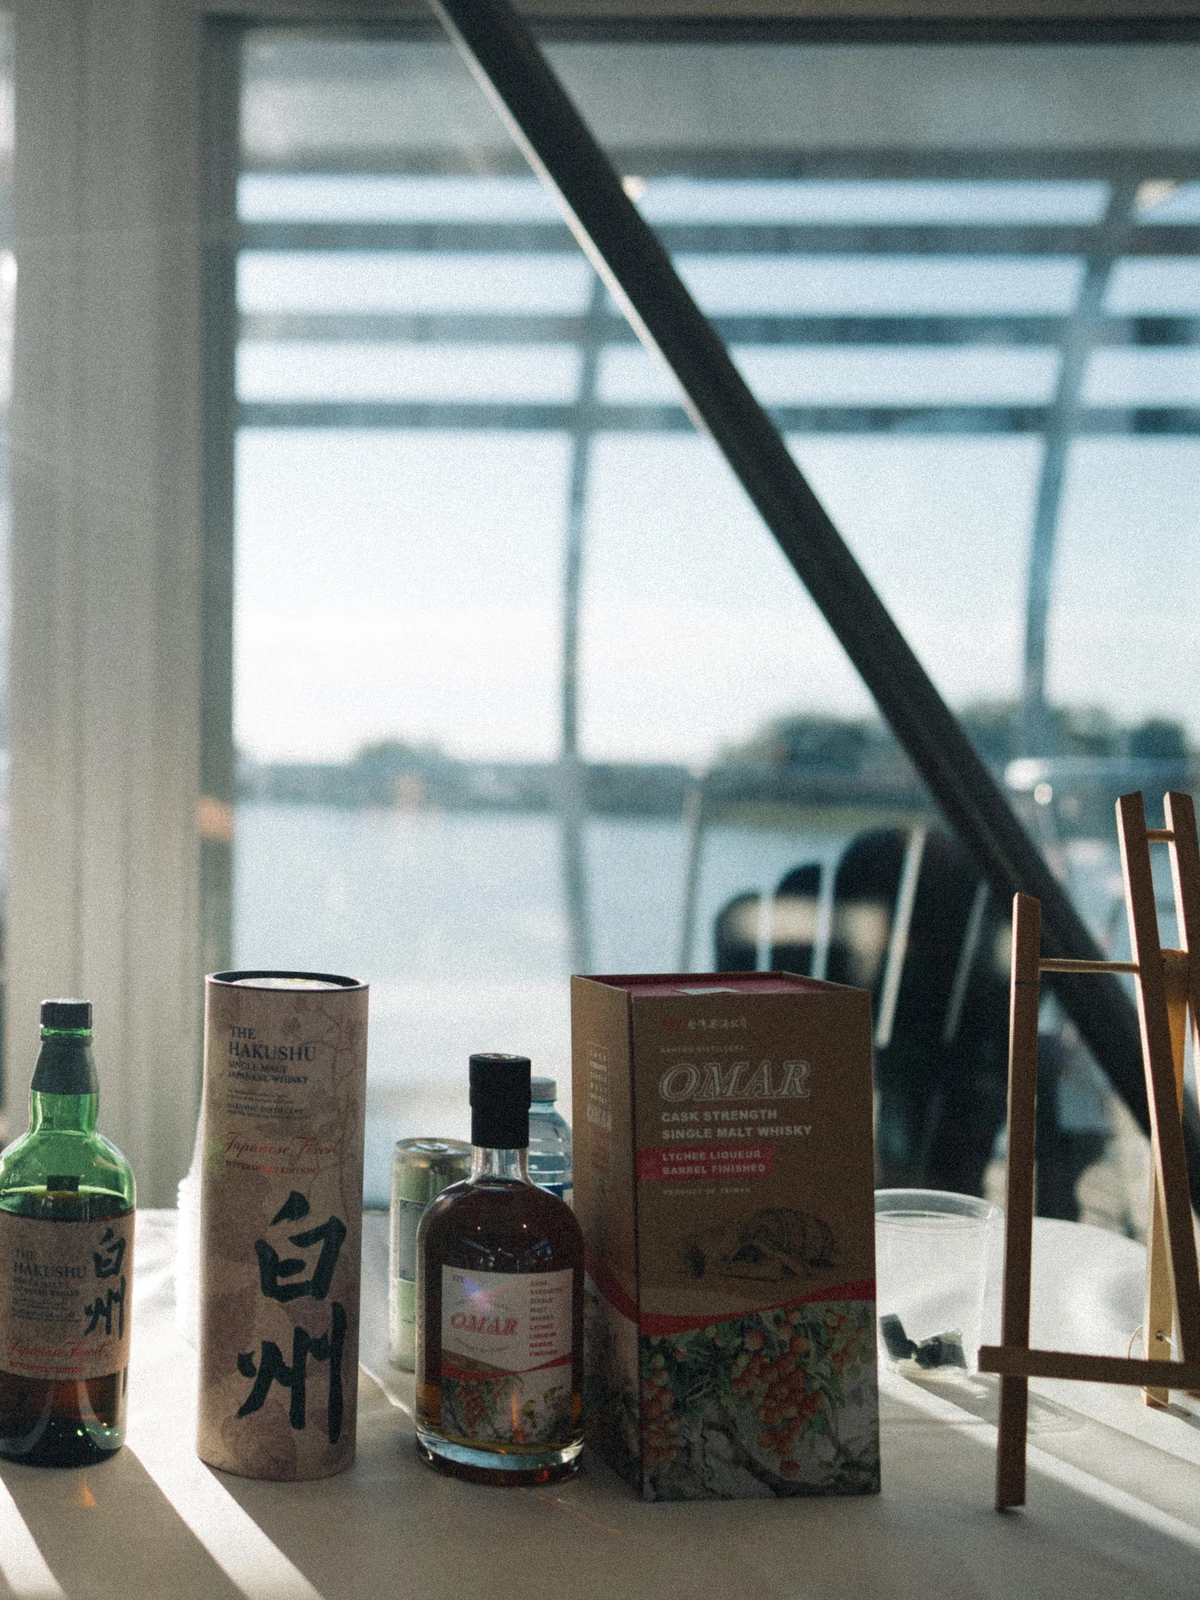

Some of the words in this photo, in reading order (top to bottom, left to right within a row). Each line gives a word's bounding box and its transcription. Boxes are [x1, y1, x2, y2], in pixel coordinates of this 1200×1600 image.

[228, 1025, 258, 1041] THE
[228, 1041, 318, 1062] HAKUSHU
[270, 1075, 310, 1085] WHISKY
[659, 1060, 812, 1102] OMAR
[661, 1111, 699, 1123] CASK
[703, 1109, 778, 1122] STRENGTH
[661, 1127, 713, 1140] SINGLE
[716, 1126, 754, 1138] MALT
[756, 1124, 813, 1137] WHISKY
[662, 1151, 706, 1162] LYCHEE
[710, 1149, 762, 1160] LIQUEUR
[662, 1164, 708, 1175] BARREL
[711, 1163, 767, 1174] FINISHED
[13, 1261, 88, 1279] HAKUSHU
[84, 1227, 127, 1341] 白州
[237, 1190, 347, 1444] 白州
[450, 1312, 518, 1337] OMAR
